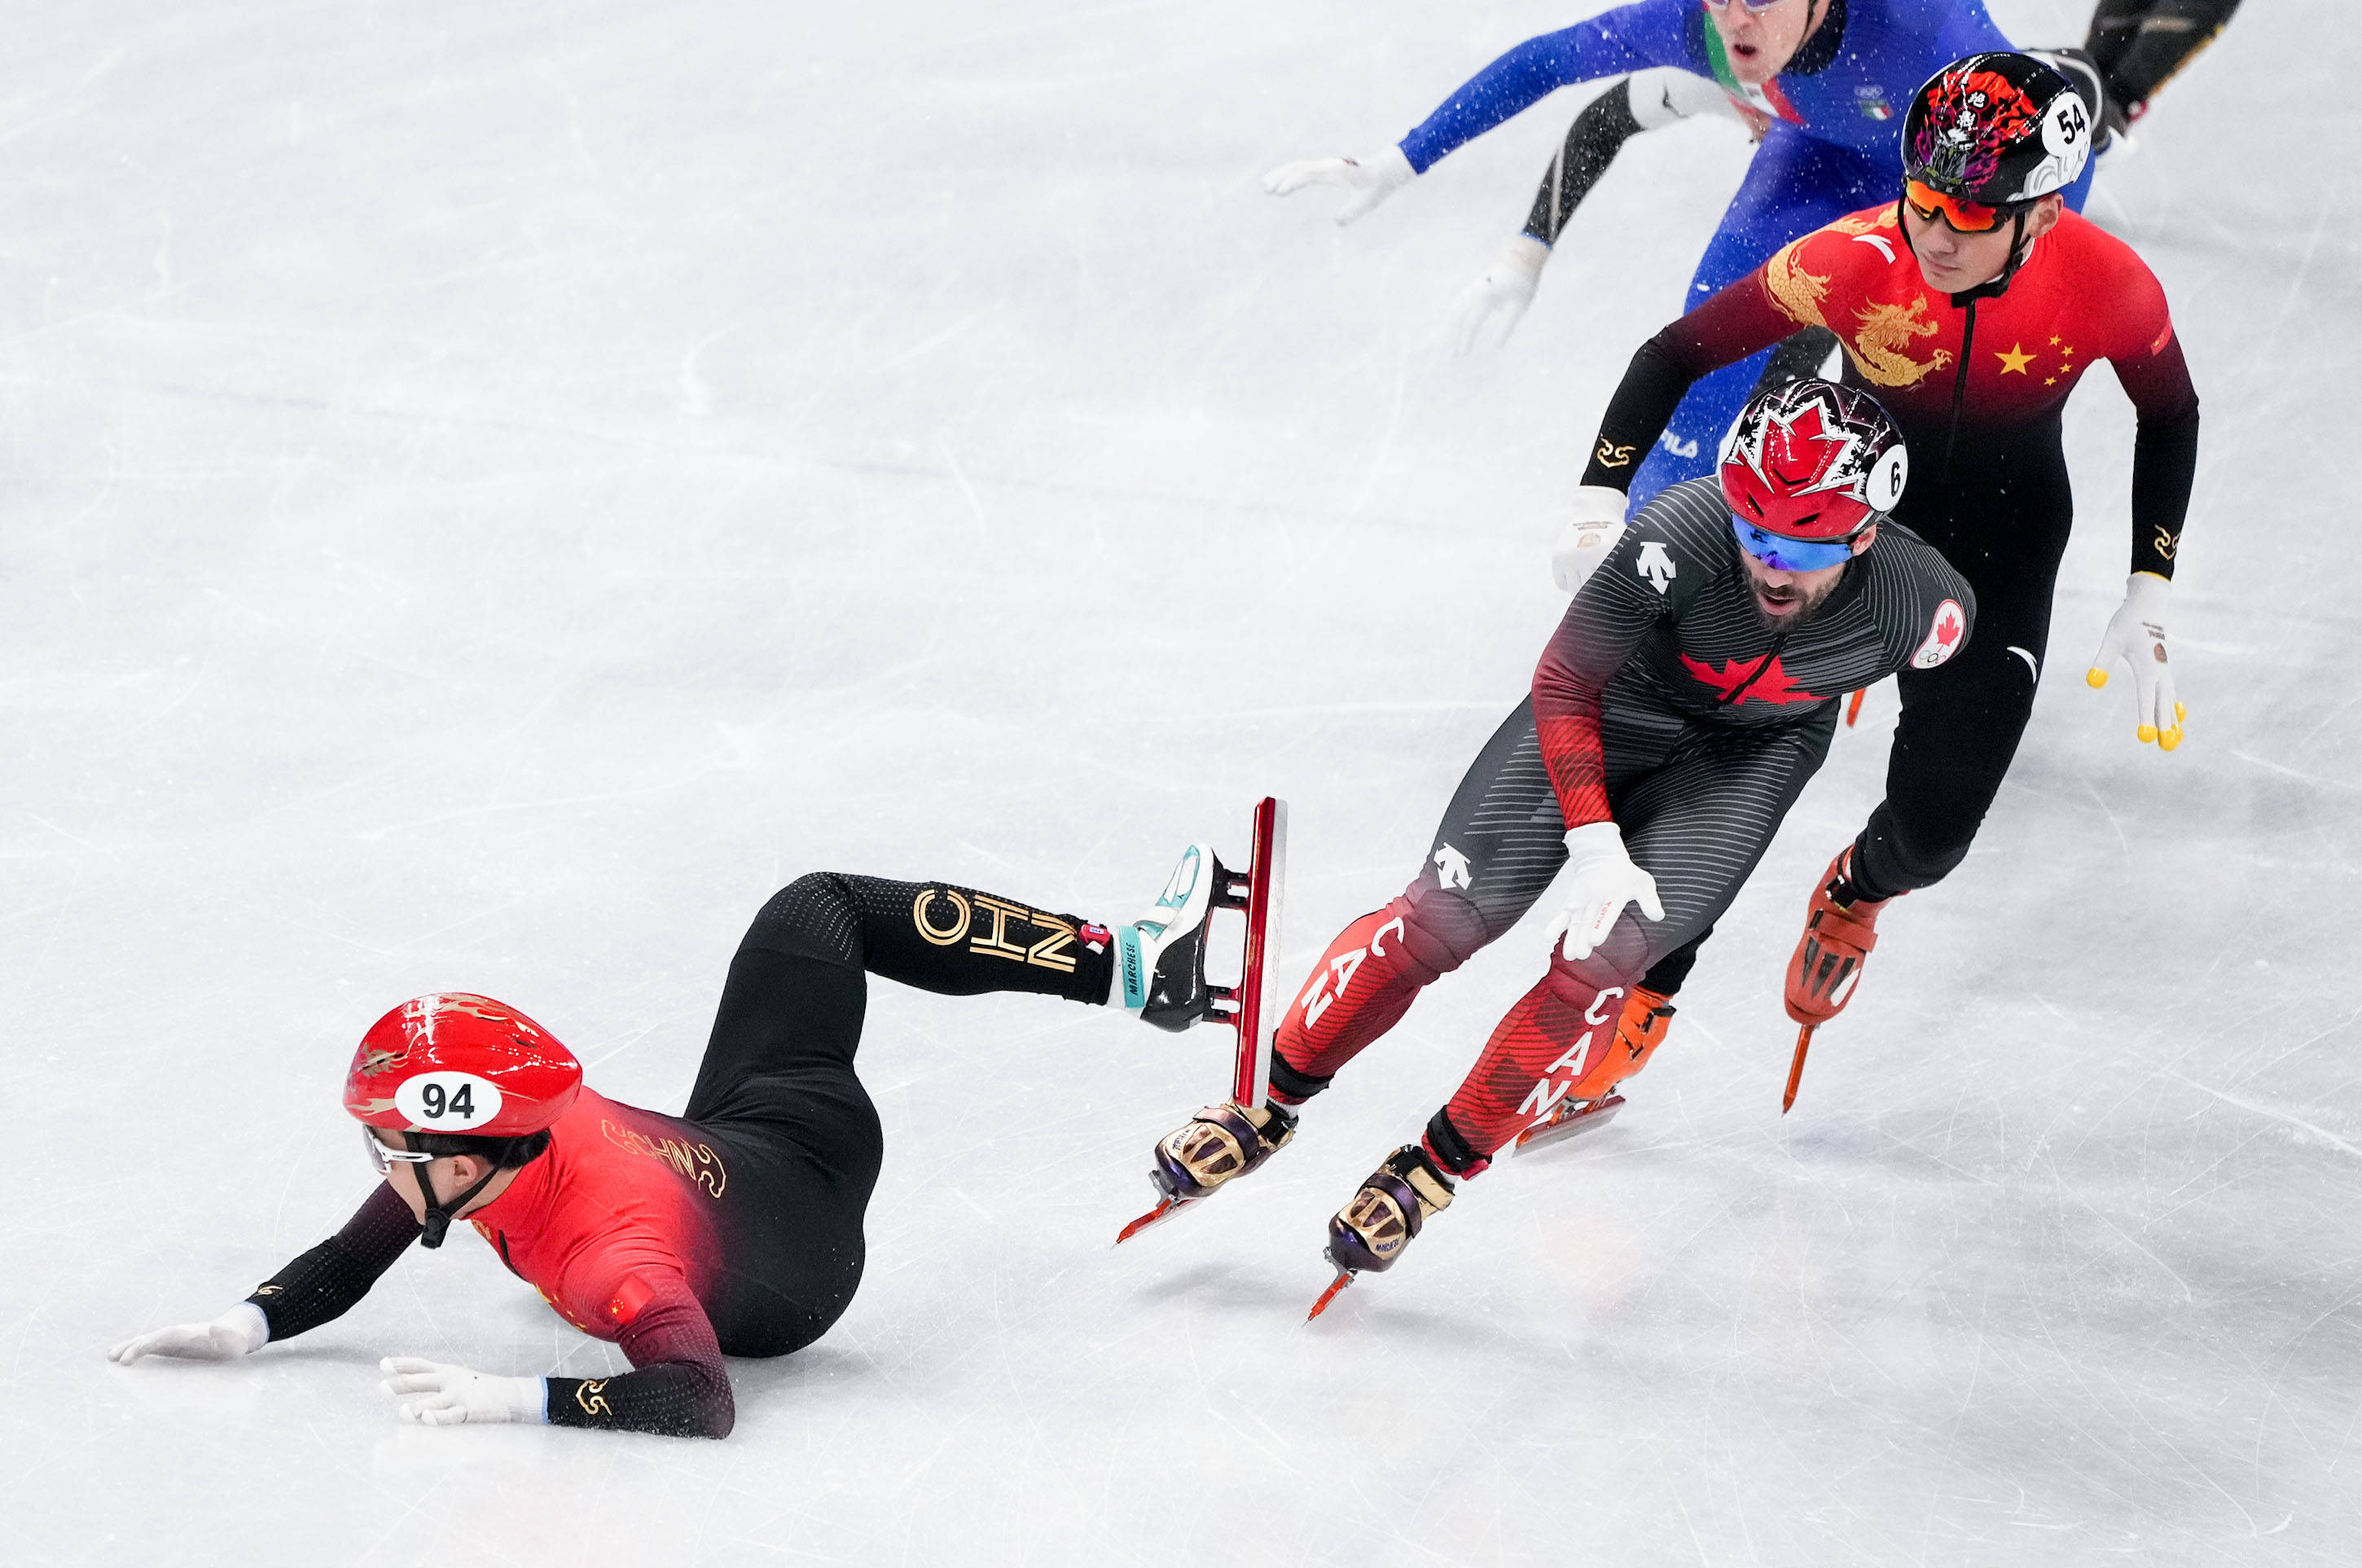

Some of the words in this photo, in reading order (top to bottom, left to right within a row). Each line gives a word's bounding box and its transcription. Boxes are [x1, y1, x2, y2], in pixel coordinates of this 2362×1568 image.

[2057, 103, 2086, 145] 54
[1889, 461, 1901, 497] 6
[913, 889, 1077, 973] CHN
[1126, 942, 1139, 996] MARCHESE
[1301, 916, 1404, 1030] CAN
[1516, 986, 1625, 1117] CAN
[422, 1083, 475, 1120] 94
